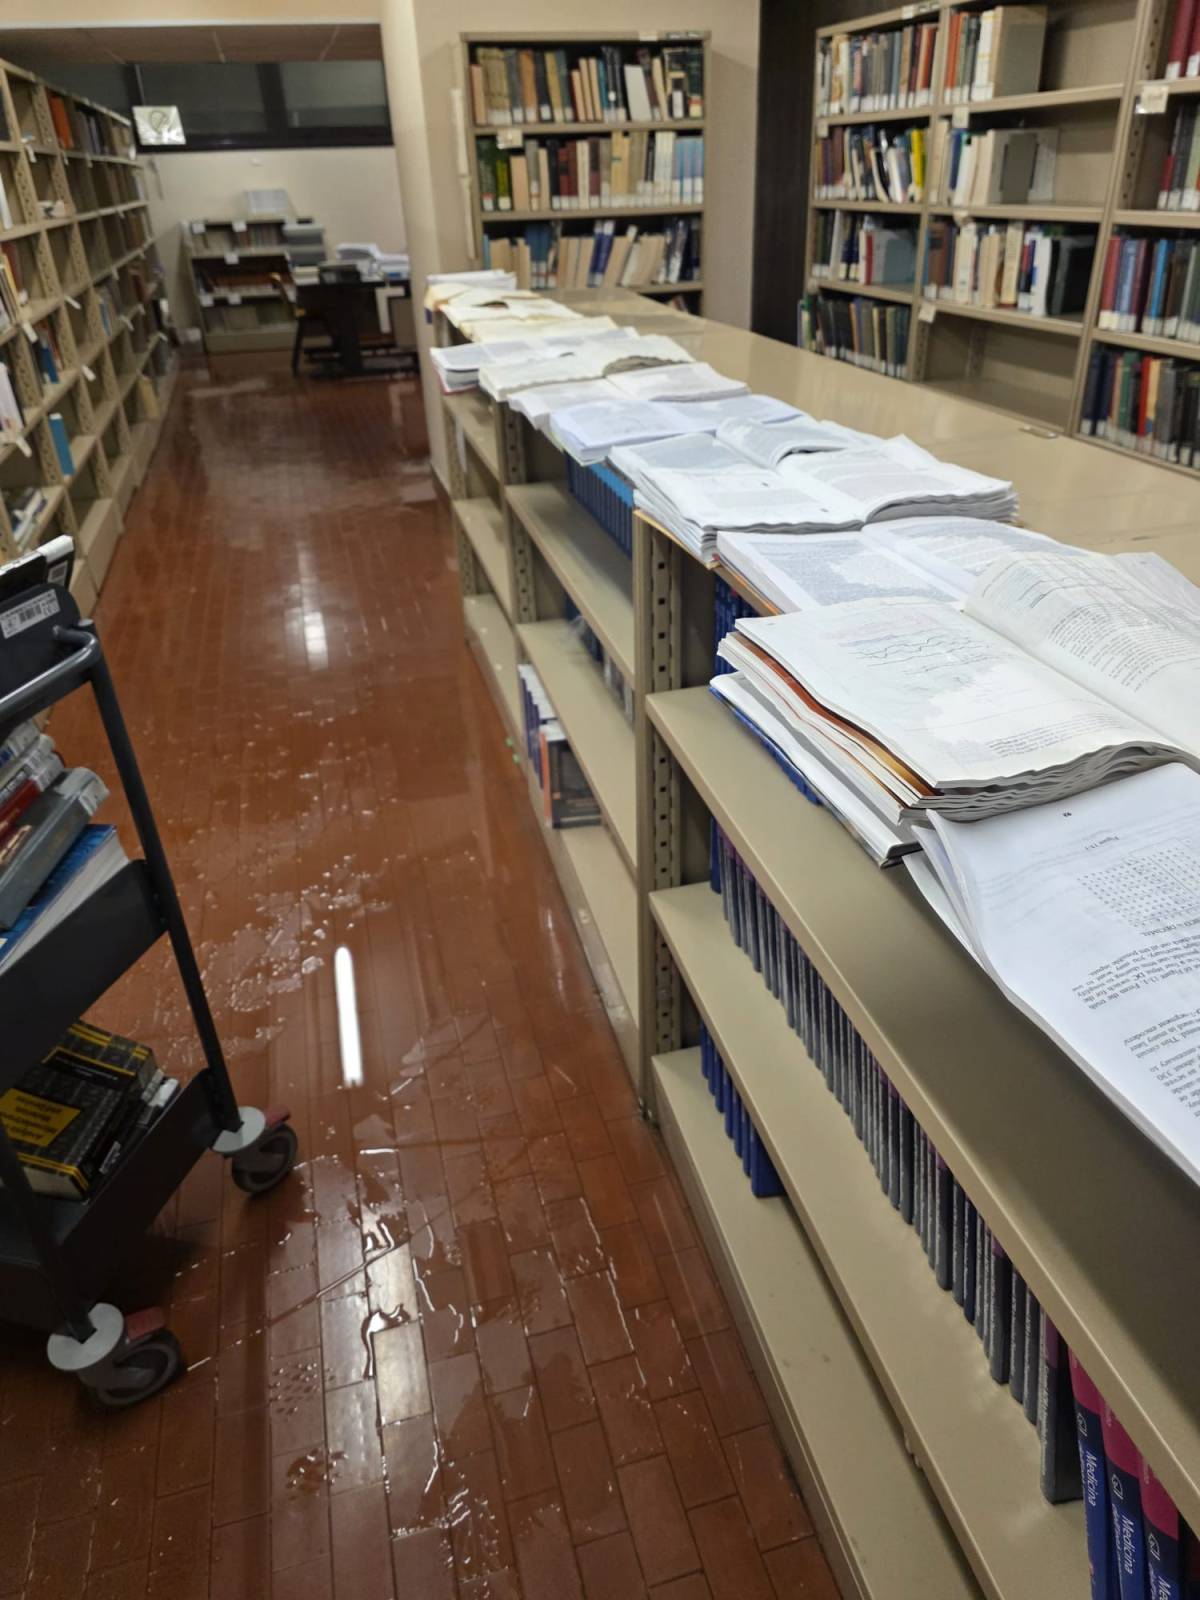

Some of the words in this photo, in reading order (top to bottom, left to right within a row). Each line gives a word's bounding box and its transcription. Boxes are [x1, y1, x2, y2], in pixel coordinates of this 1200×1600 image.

[1106, 991, 1120, 1002] the
[1086, 1450, 1097, 1506] Medicina
[1122, 1514, 1134, 1574] Medicina
